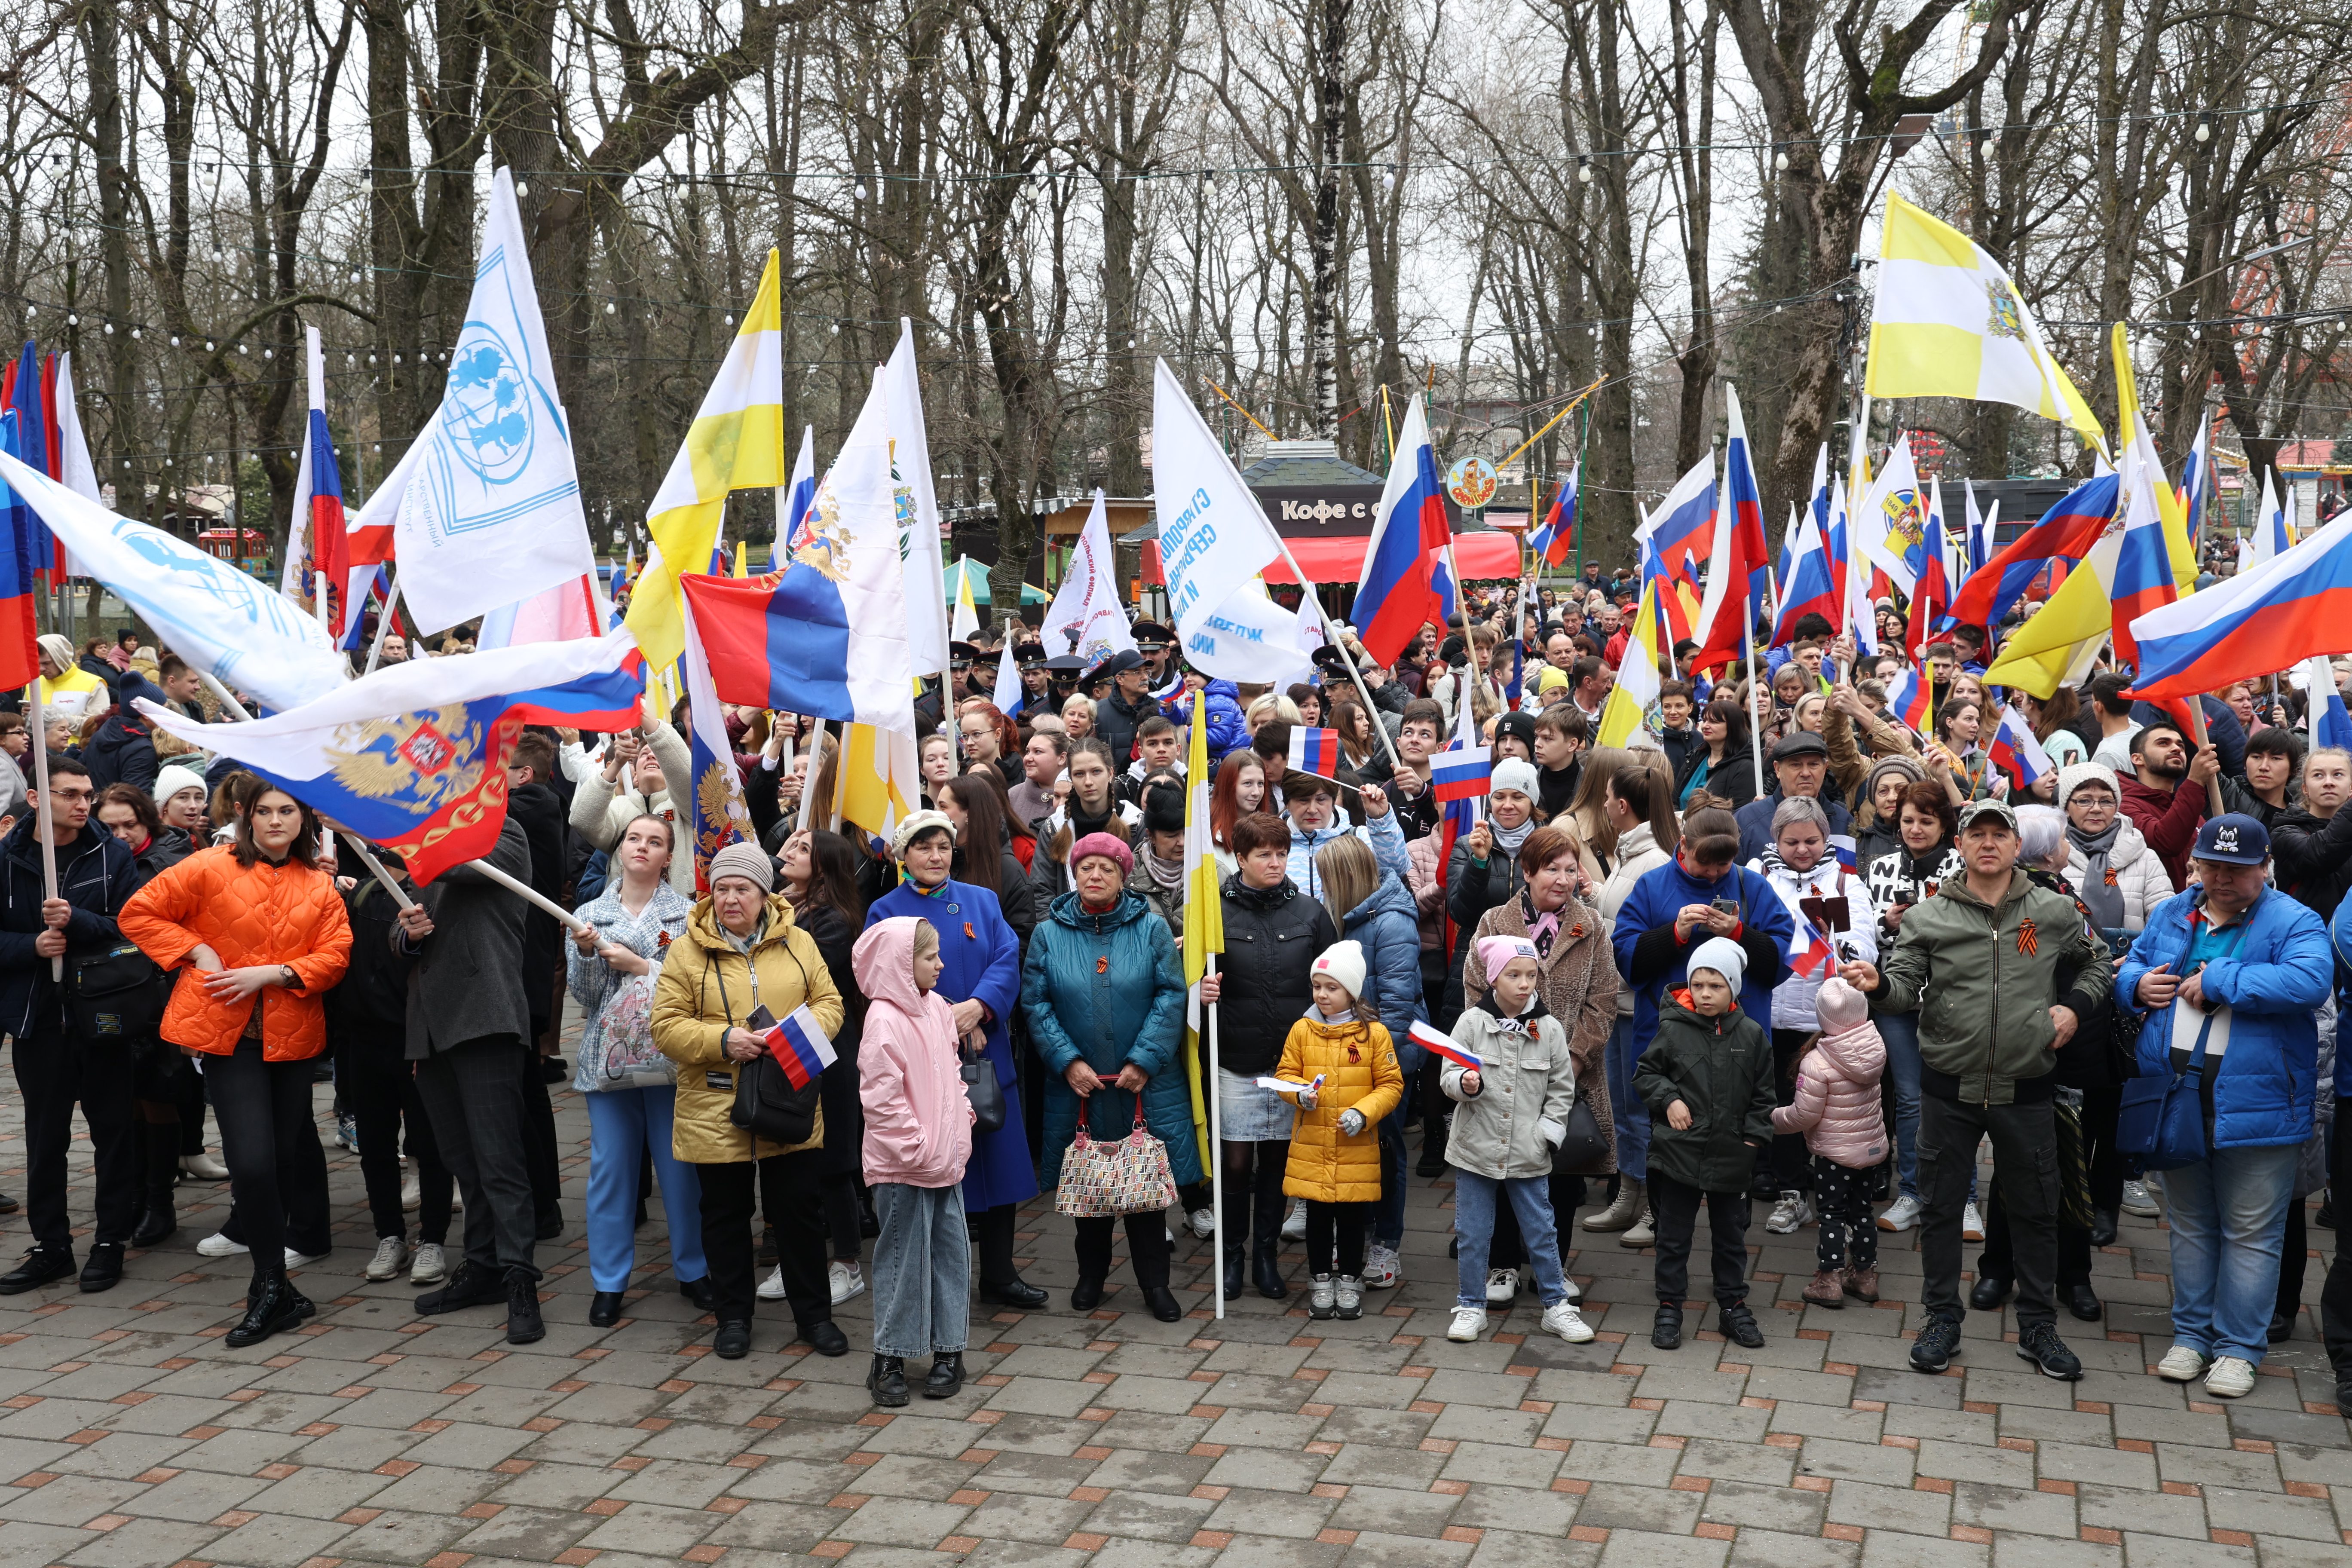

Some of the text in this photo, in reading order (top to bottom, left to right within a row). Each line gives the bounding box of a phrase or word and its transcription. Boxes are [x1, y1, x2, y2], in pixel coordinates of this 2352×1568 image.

[1452, 477, 1496, 506] CORN DOGS
[1885, 497, 1898, 511] 1849
[1281, 500, 1345, 524] Кофе
[1352, 503, 1366, 518] с
[1082, 576, 1095, 606] ФИЛИАЛ
